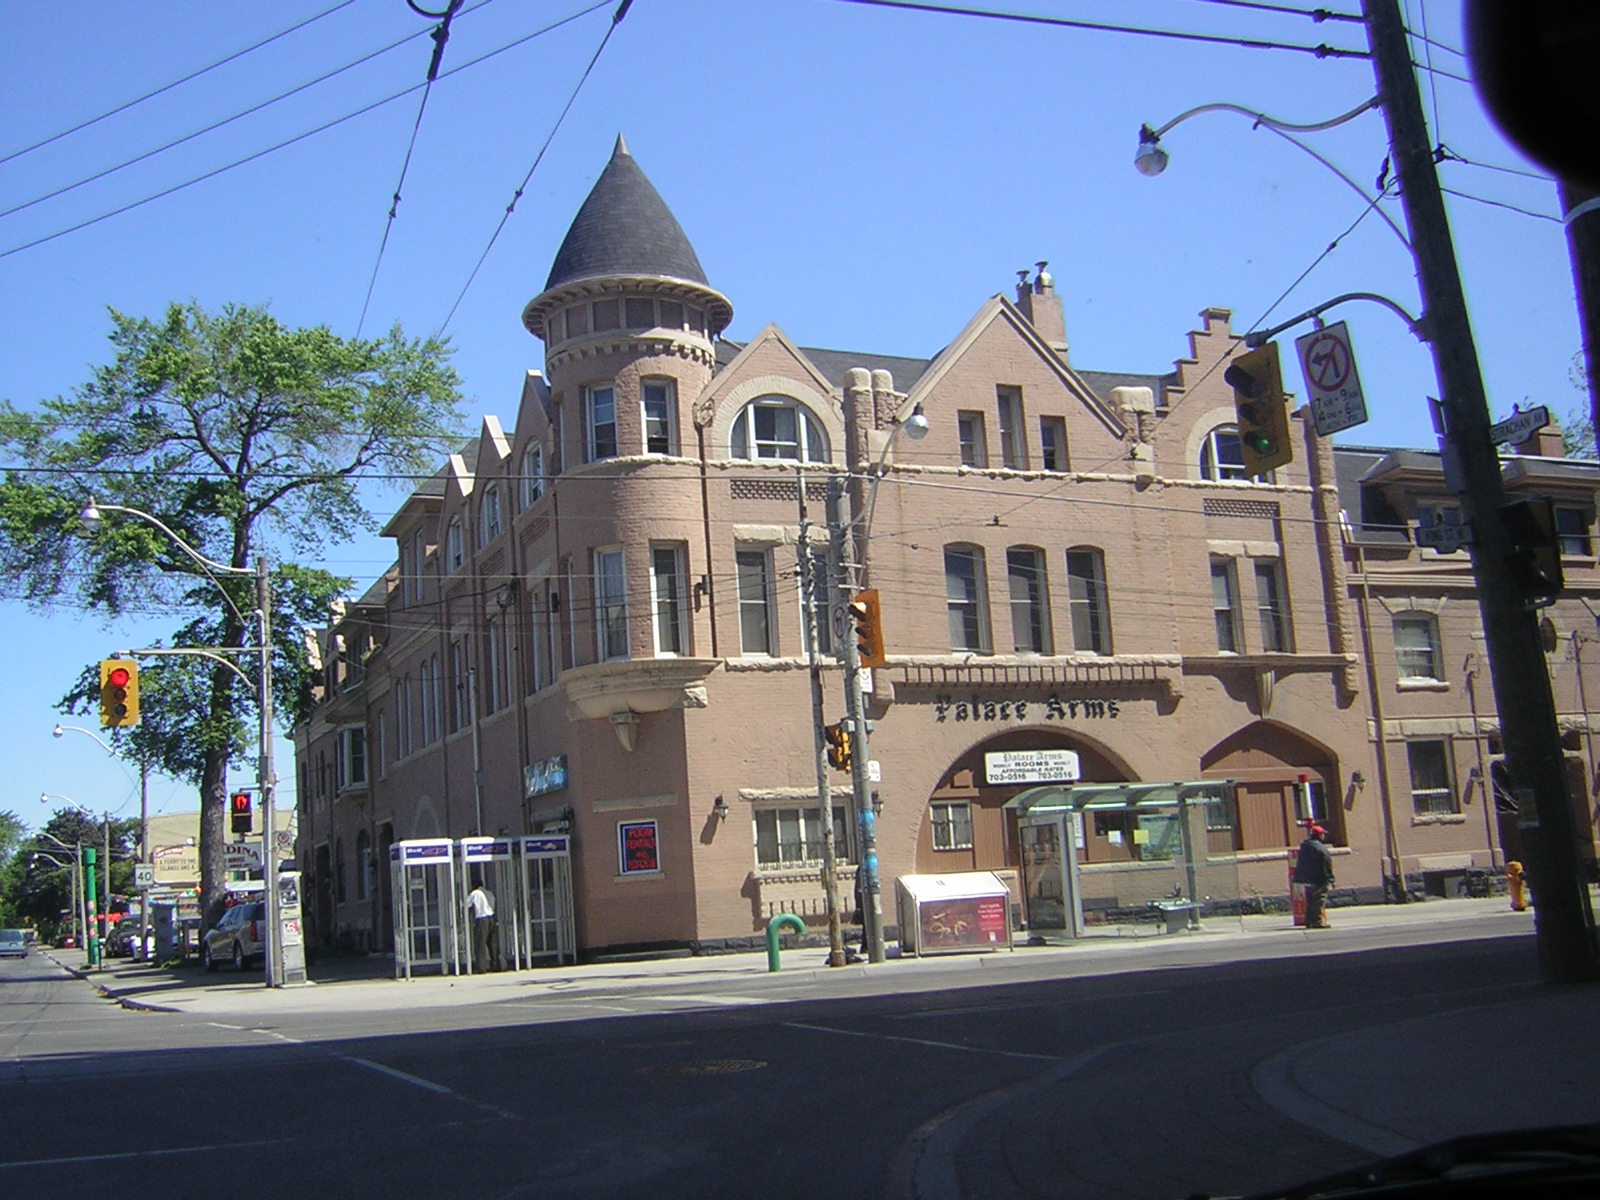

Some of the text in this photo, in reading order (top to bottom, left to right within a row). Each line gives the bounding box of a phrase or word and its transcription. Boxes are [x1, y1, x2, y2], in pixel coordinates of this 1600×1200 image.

[935, 693, 1120, 723] Palace Arms
[1003, 751, 1063, 762] Palace Arms
[1038, 771, 1073, 780] 703-0516
[137, 871, 153, 881] 40
